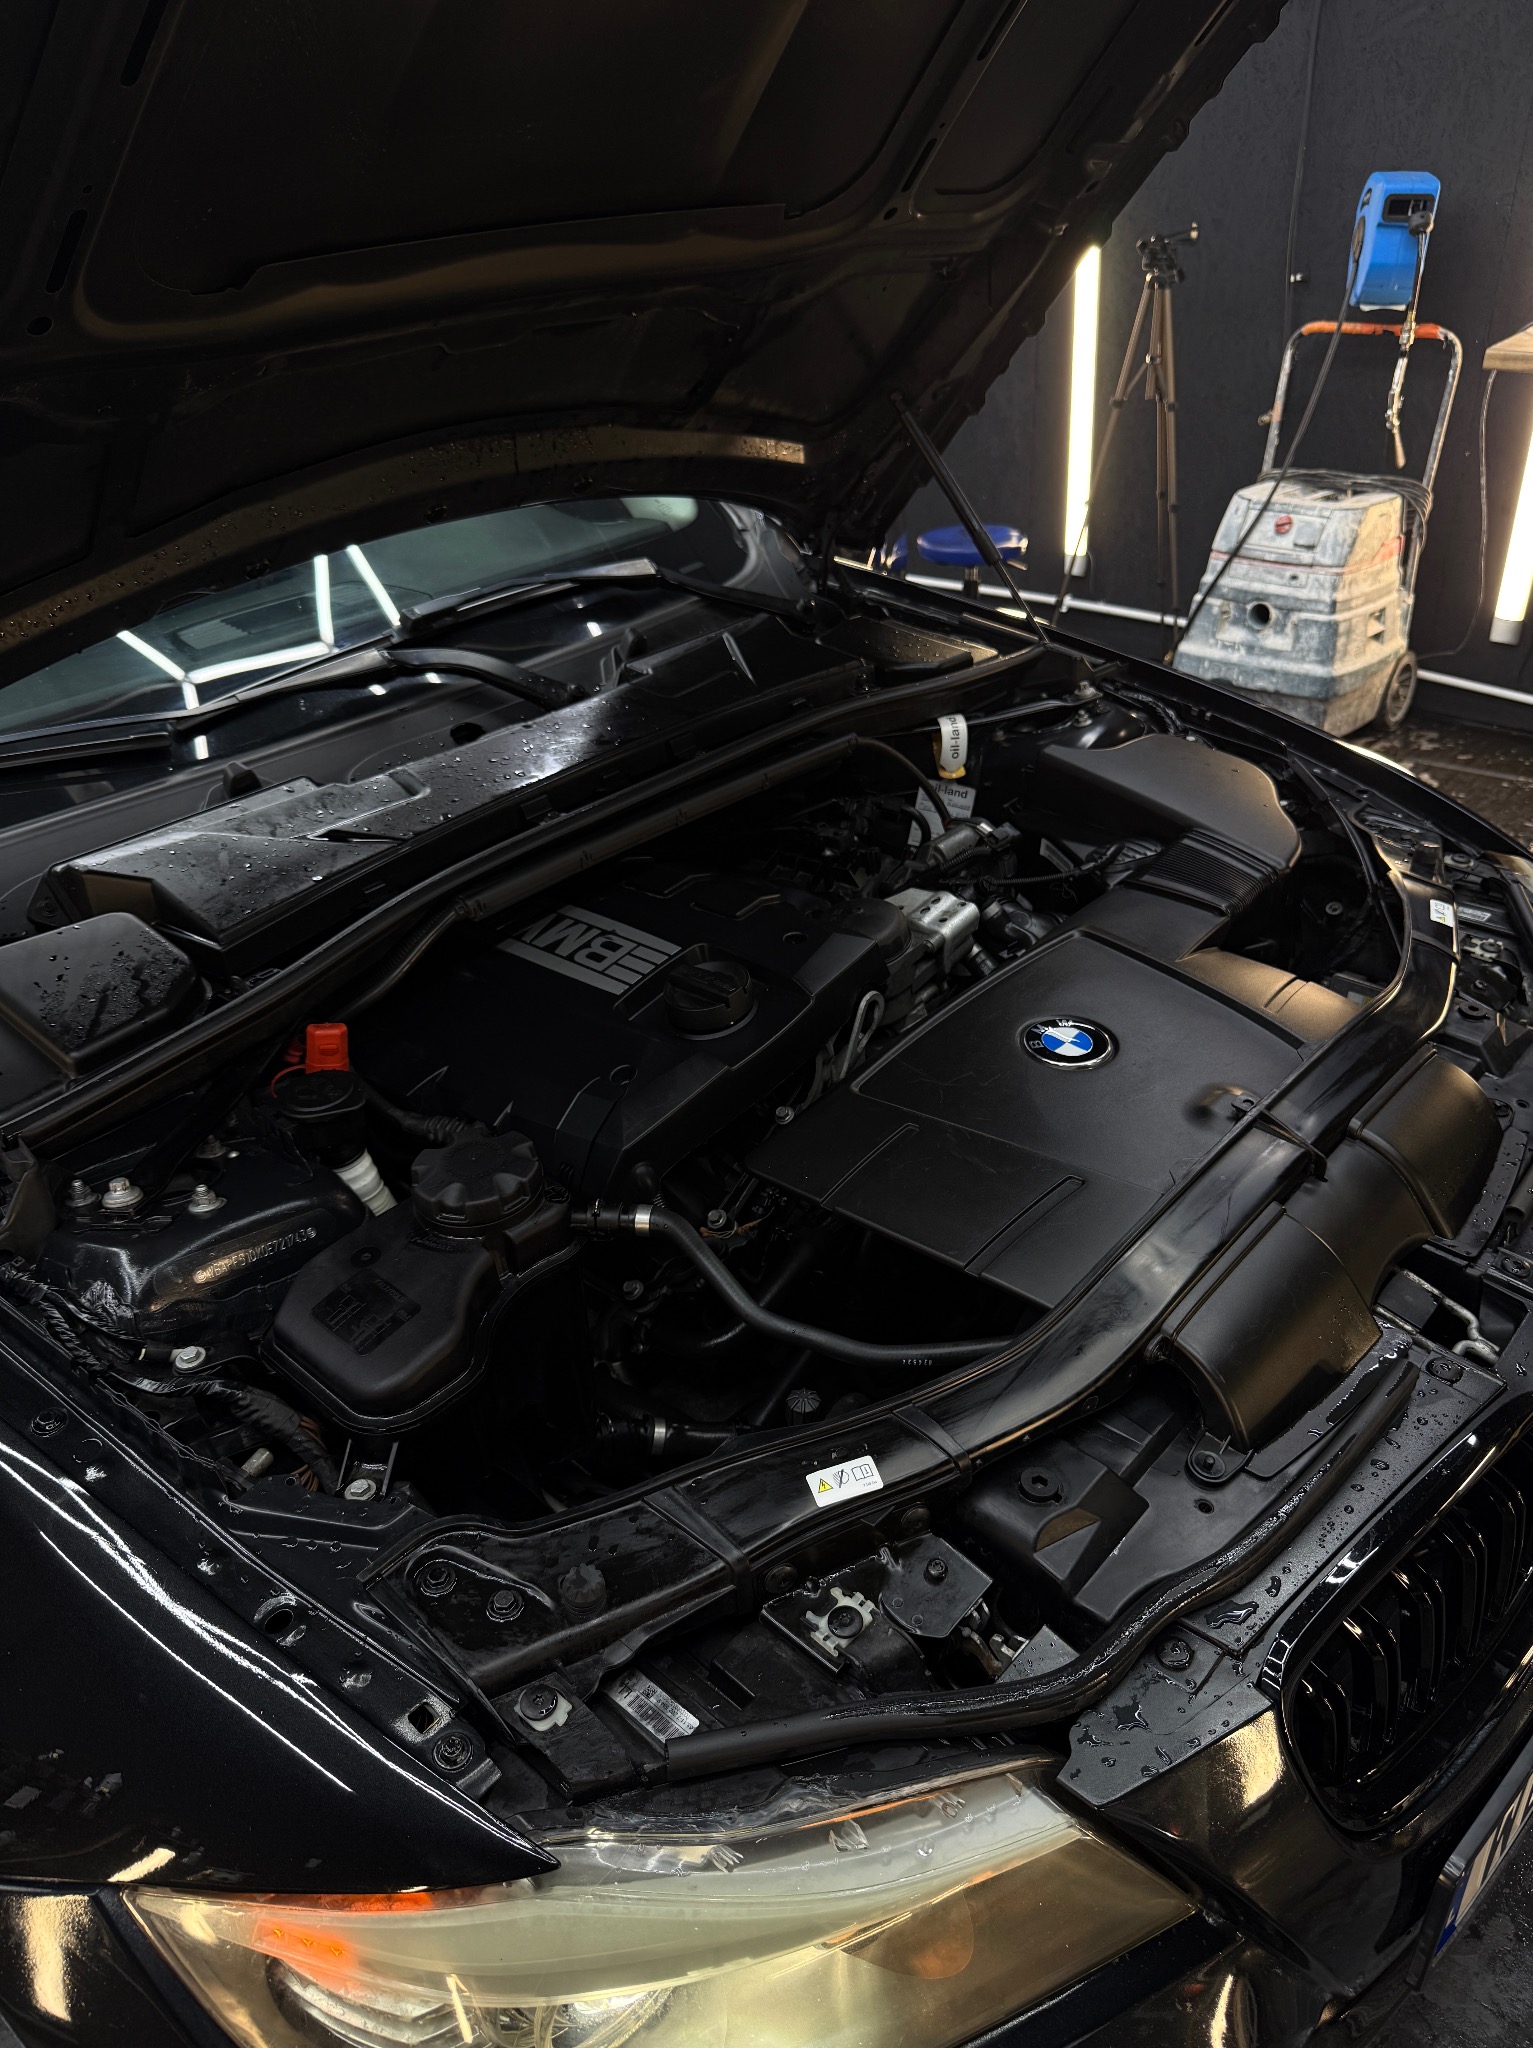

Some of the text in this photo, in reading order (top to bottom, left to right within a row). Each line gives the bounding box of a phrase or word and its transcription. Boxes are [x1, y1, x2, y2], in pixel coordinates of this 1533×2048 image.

[946, 716, 960, 760] oil-land
[934, 783, 968, 799] il-land
[1029, 1019, 1073, 1049] BMW
